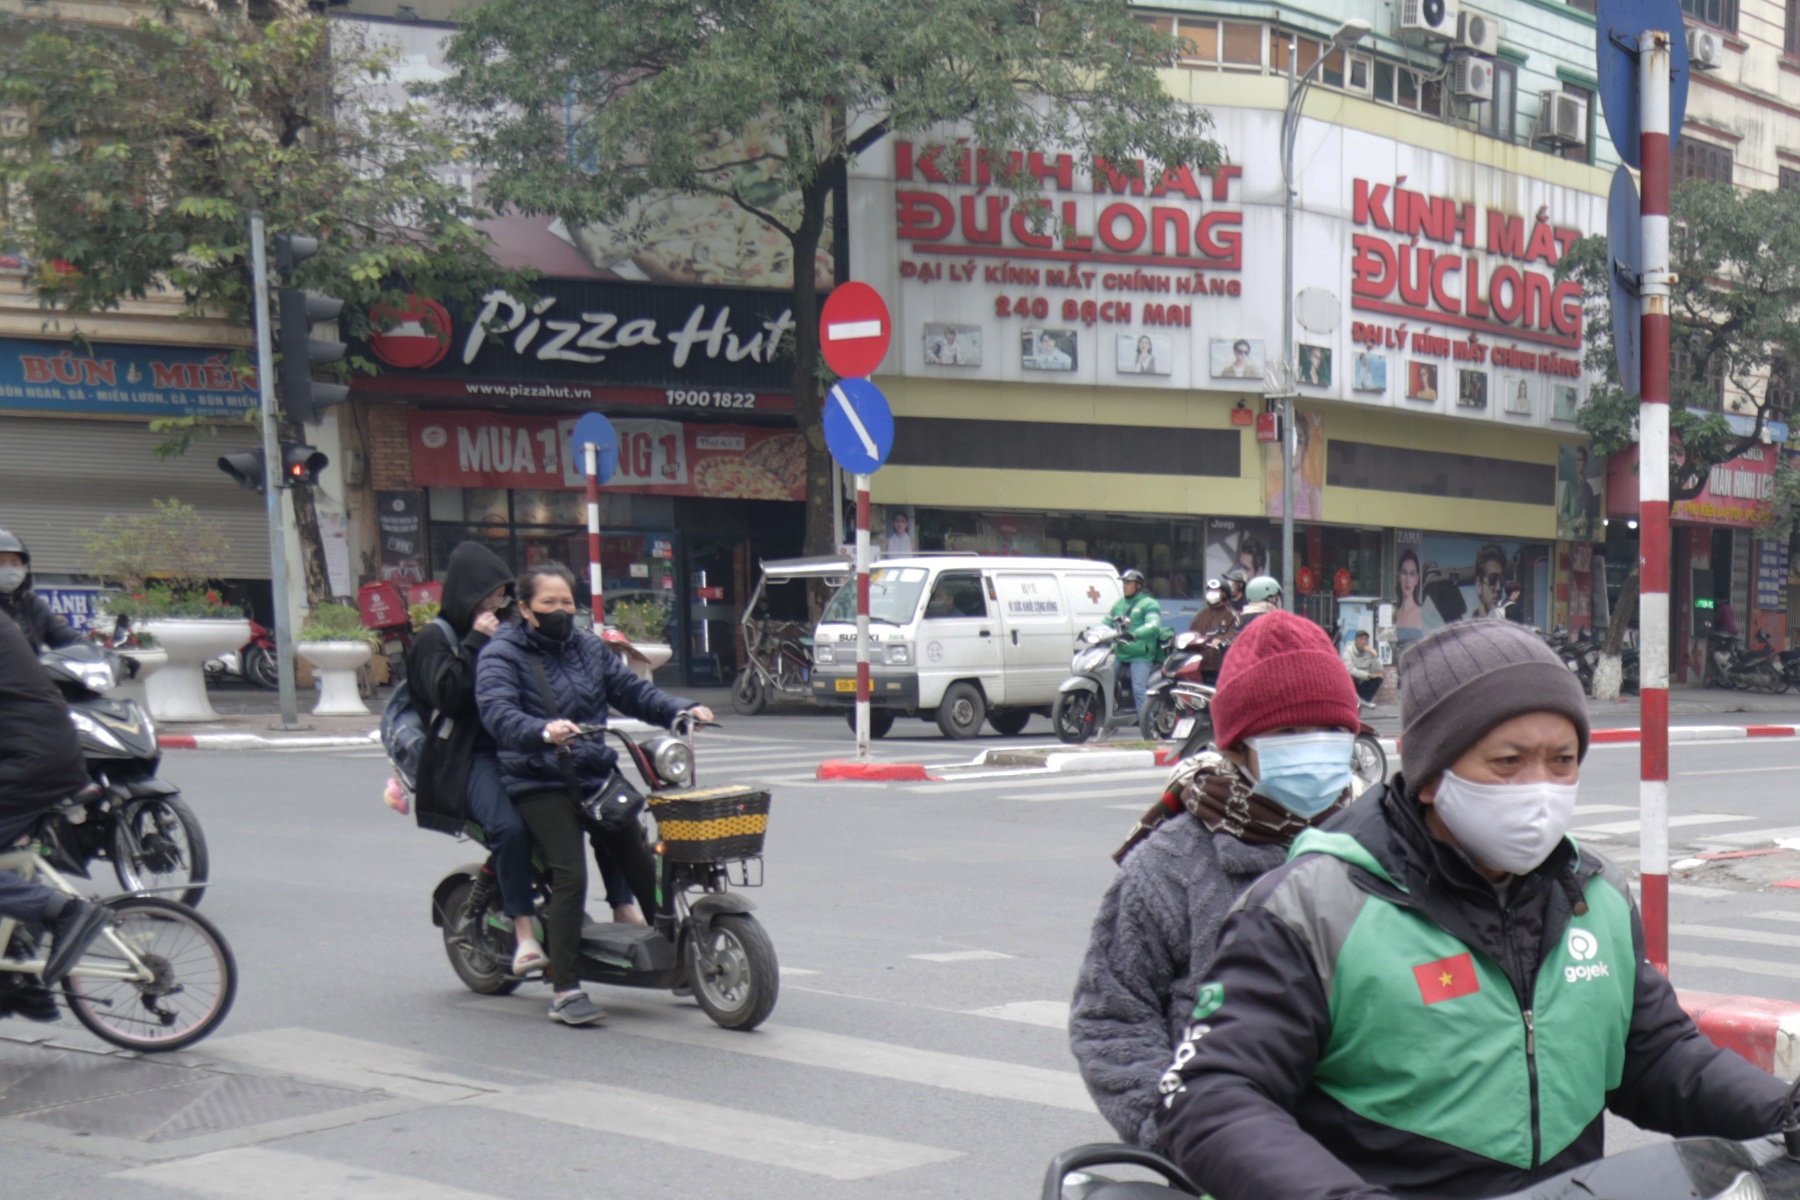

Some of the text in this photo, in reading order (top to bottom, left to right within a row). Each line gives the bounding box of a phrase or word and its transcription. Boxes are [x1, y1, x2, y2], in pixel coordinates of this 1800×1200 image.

[1353, 175, 1583, 267] KÍNH MẮT
[900, 260, 942, 284] ĐẠI
[949, 259, 978, 283] LÝ
[985, 260, 1040, 286] KÍNH
[1045, 261, 1096, 288] MẮT
[1103, 268, 1171, 293] CHÍNH
[995, 295, 1192, 327] 240 BẠCH MAI
[463, 289, 796, 368] Pizza Hut
[1352, 321, 1383, 351] ĐẠI
[1386, 323, 1408, 349] LÝ
[1412, 327, 1450, 356] KÍNH
[19, 350, 260, 392] BÚN MIẾN
[466, 382, 592, 399] www.pizzahut.vn
[458, 427, 536, 474] MUA
[1211, 520, 1235, 530] Jeep
[1565, 961, 1610, 983] gojek
